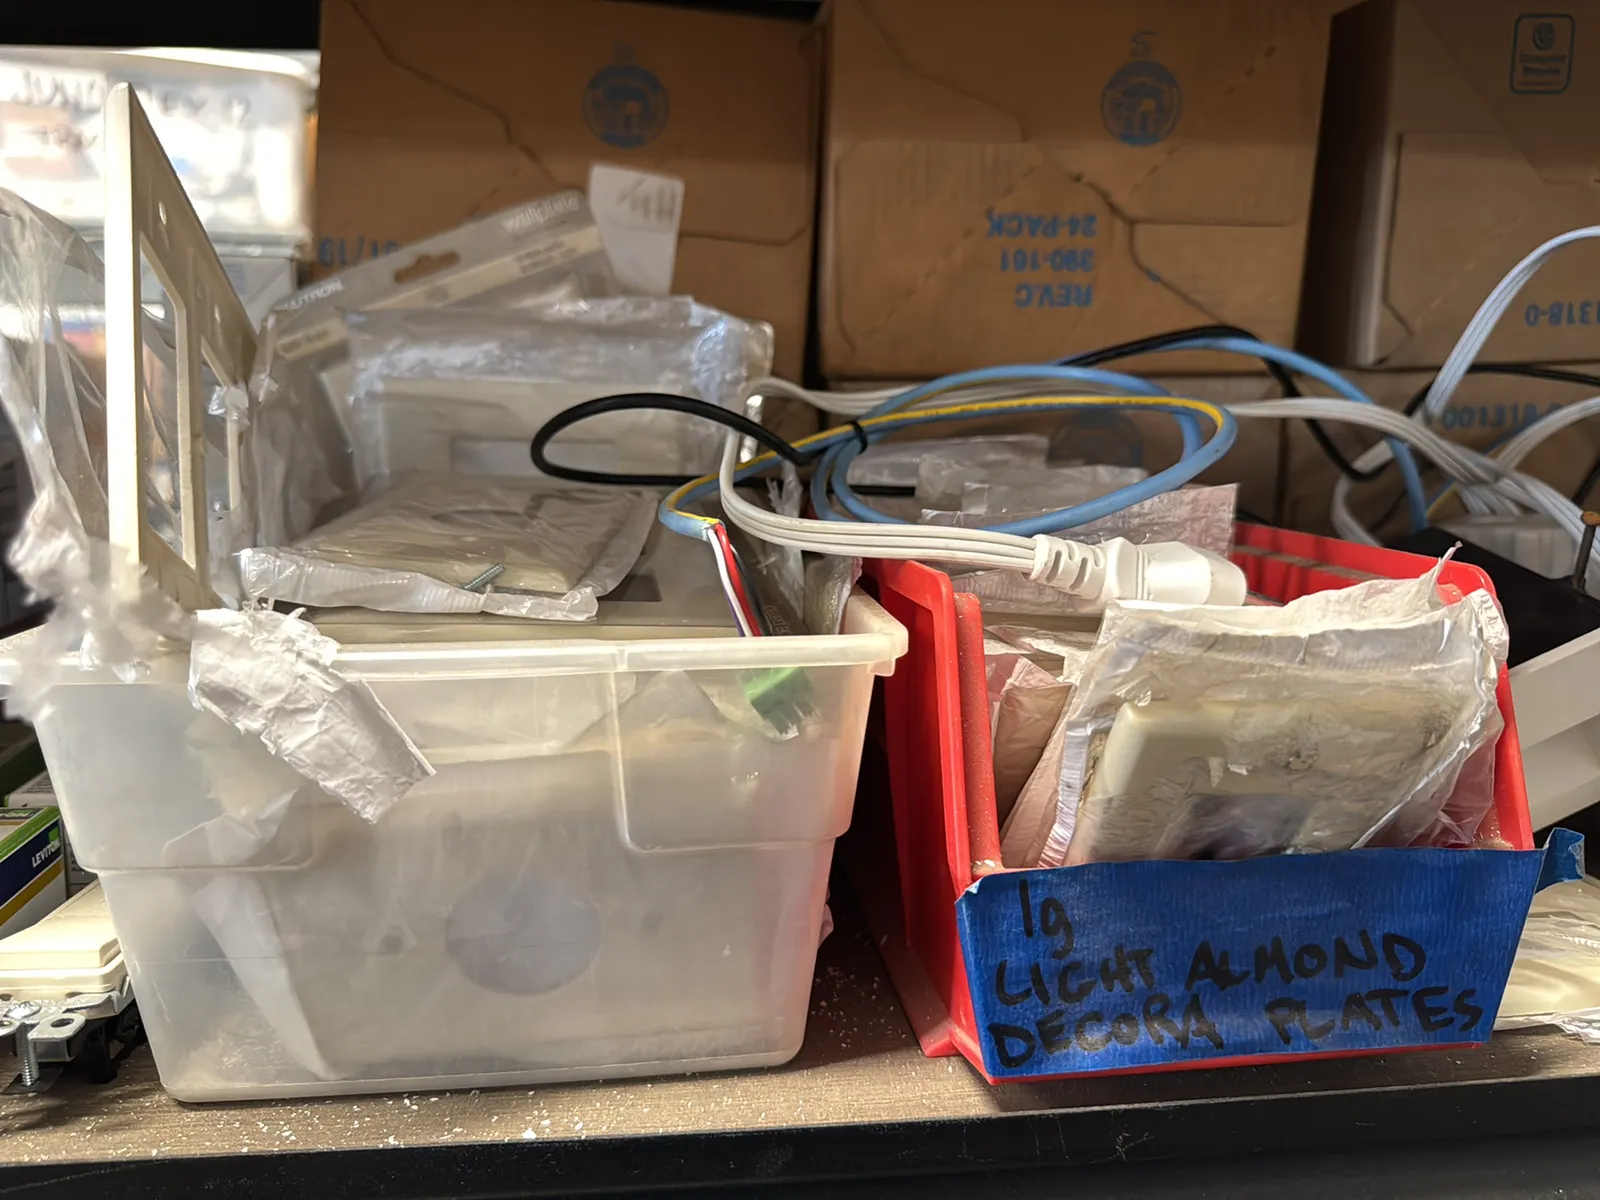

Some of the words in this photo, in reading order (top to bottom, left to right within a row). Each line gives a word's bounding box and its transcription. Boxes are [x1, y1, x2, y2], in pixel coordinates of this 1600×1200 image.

[986, 211, 1098, 238] 24-PACK
[994, 945, 1155, 1010] LIGHT
[1184, 929, 1427, 992] ALMOND
[987, 993, 1225, 1069] DECORA
[1264, 985, 1484, 1045] PLATES
